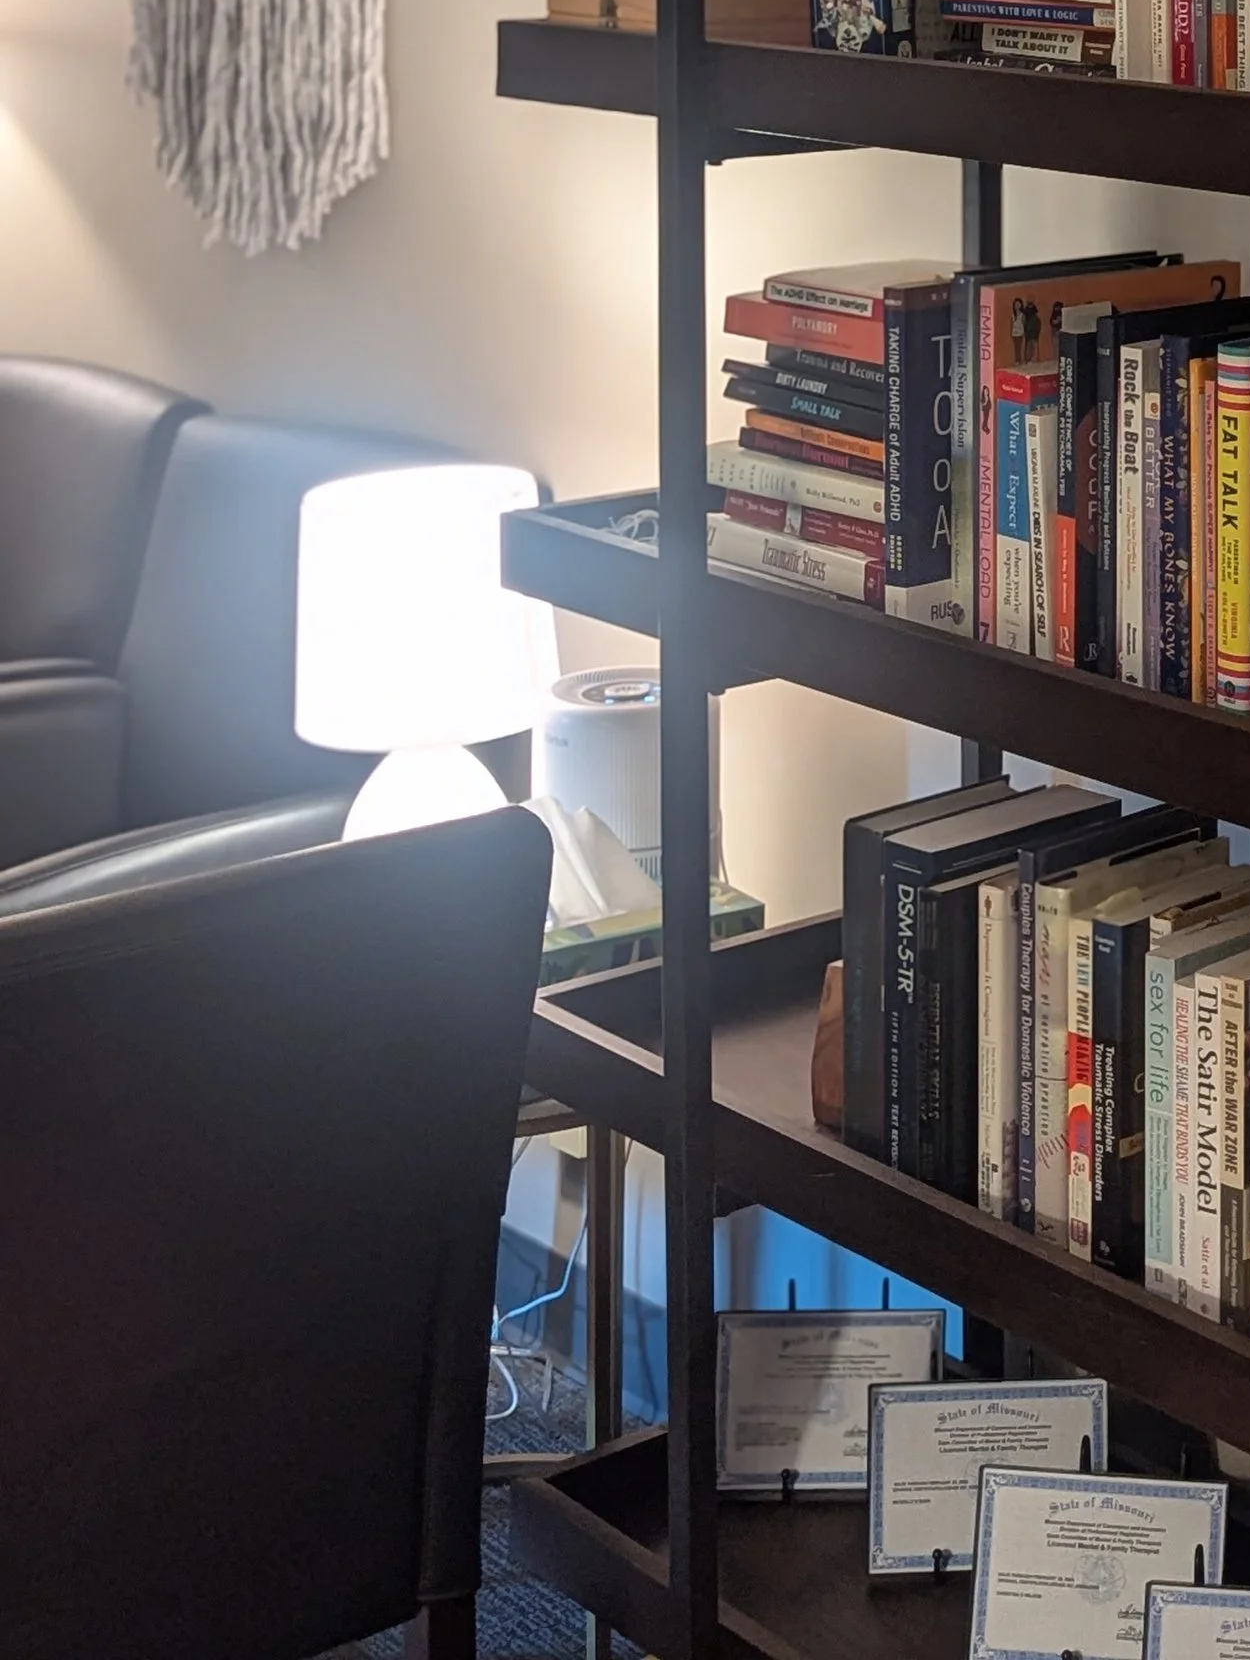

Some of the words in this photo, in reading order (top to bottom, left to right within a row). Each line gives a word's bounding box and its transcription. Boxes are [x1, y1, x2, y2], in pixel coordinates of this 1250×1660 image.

[1238, 46, 1246, 89] THING
[980, 305, 991, 361] EMMA
[1065, 357, 1073, 383] CORE
[1123, 358, 1141, 405] Rock
[1065, 385, 1073, 456] COMPETENCIES
[1124, 409, 1133, 428] the
[1221, 415, 1238, 460] FAT
[1065, 458, 1072, 471] OF
[1124, 431, 1139, 475] Boat
[1144, 427, 1156, 509] BETTER
[1163, 435, 1175, 489] WHAT
[1163, 496, 1175, 524] MY
[1221, 470, 1238, 530] TALK
[1003, 549, 1011, 606] expecting
[1163, 531, 1175, 594] BONES
[1164, 601, 1175, 661] KNOW
[1230, 602, 1238, 639] VIRGINIA
[1020, 883, 1033, 937] Couples
[897, 884, 914, 992] DSM-5-TR
[1020, 939, 1033, 992] Therapy
[1021, 995, 1032, 1011] for
[1149, 971, 1164, 1014] sex
[1197, 986, 1219, 1041] The
[1020, 1015, 1032, 1078] Domestic
[1149, 1021, 1169, 1059] for
[1095, 1043, 1104, 1109] Traumatic
[1149, 1064, 1169, 1104] life
[1197, 1047, 1218, 1116] Satir
[1020, 1080, 1032, 1136] Violence
[1095, 1111, 1103, 1141] Stress
[1095, 1142, 1103, 1202] Disorders
[1196, 1123, 1218, 1215] Model
[971, 1404, 982, 1415] of
[985, 1402, 1041, 1423] Missouri
[1083, 1497, 1096, 1508] of
[1100, 1497, 1156, 1524] Missouri
